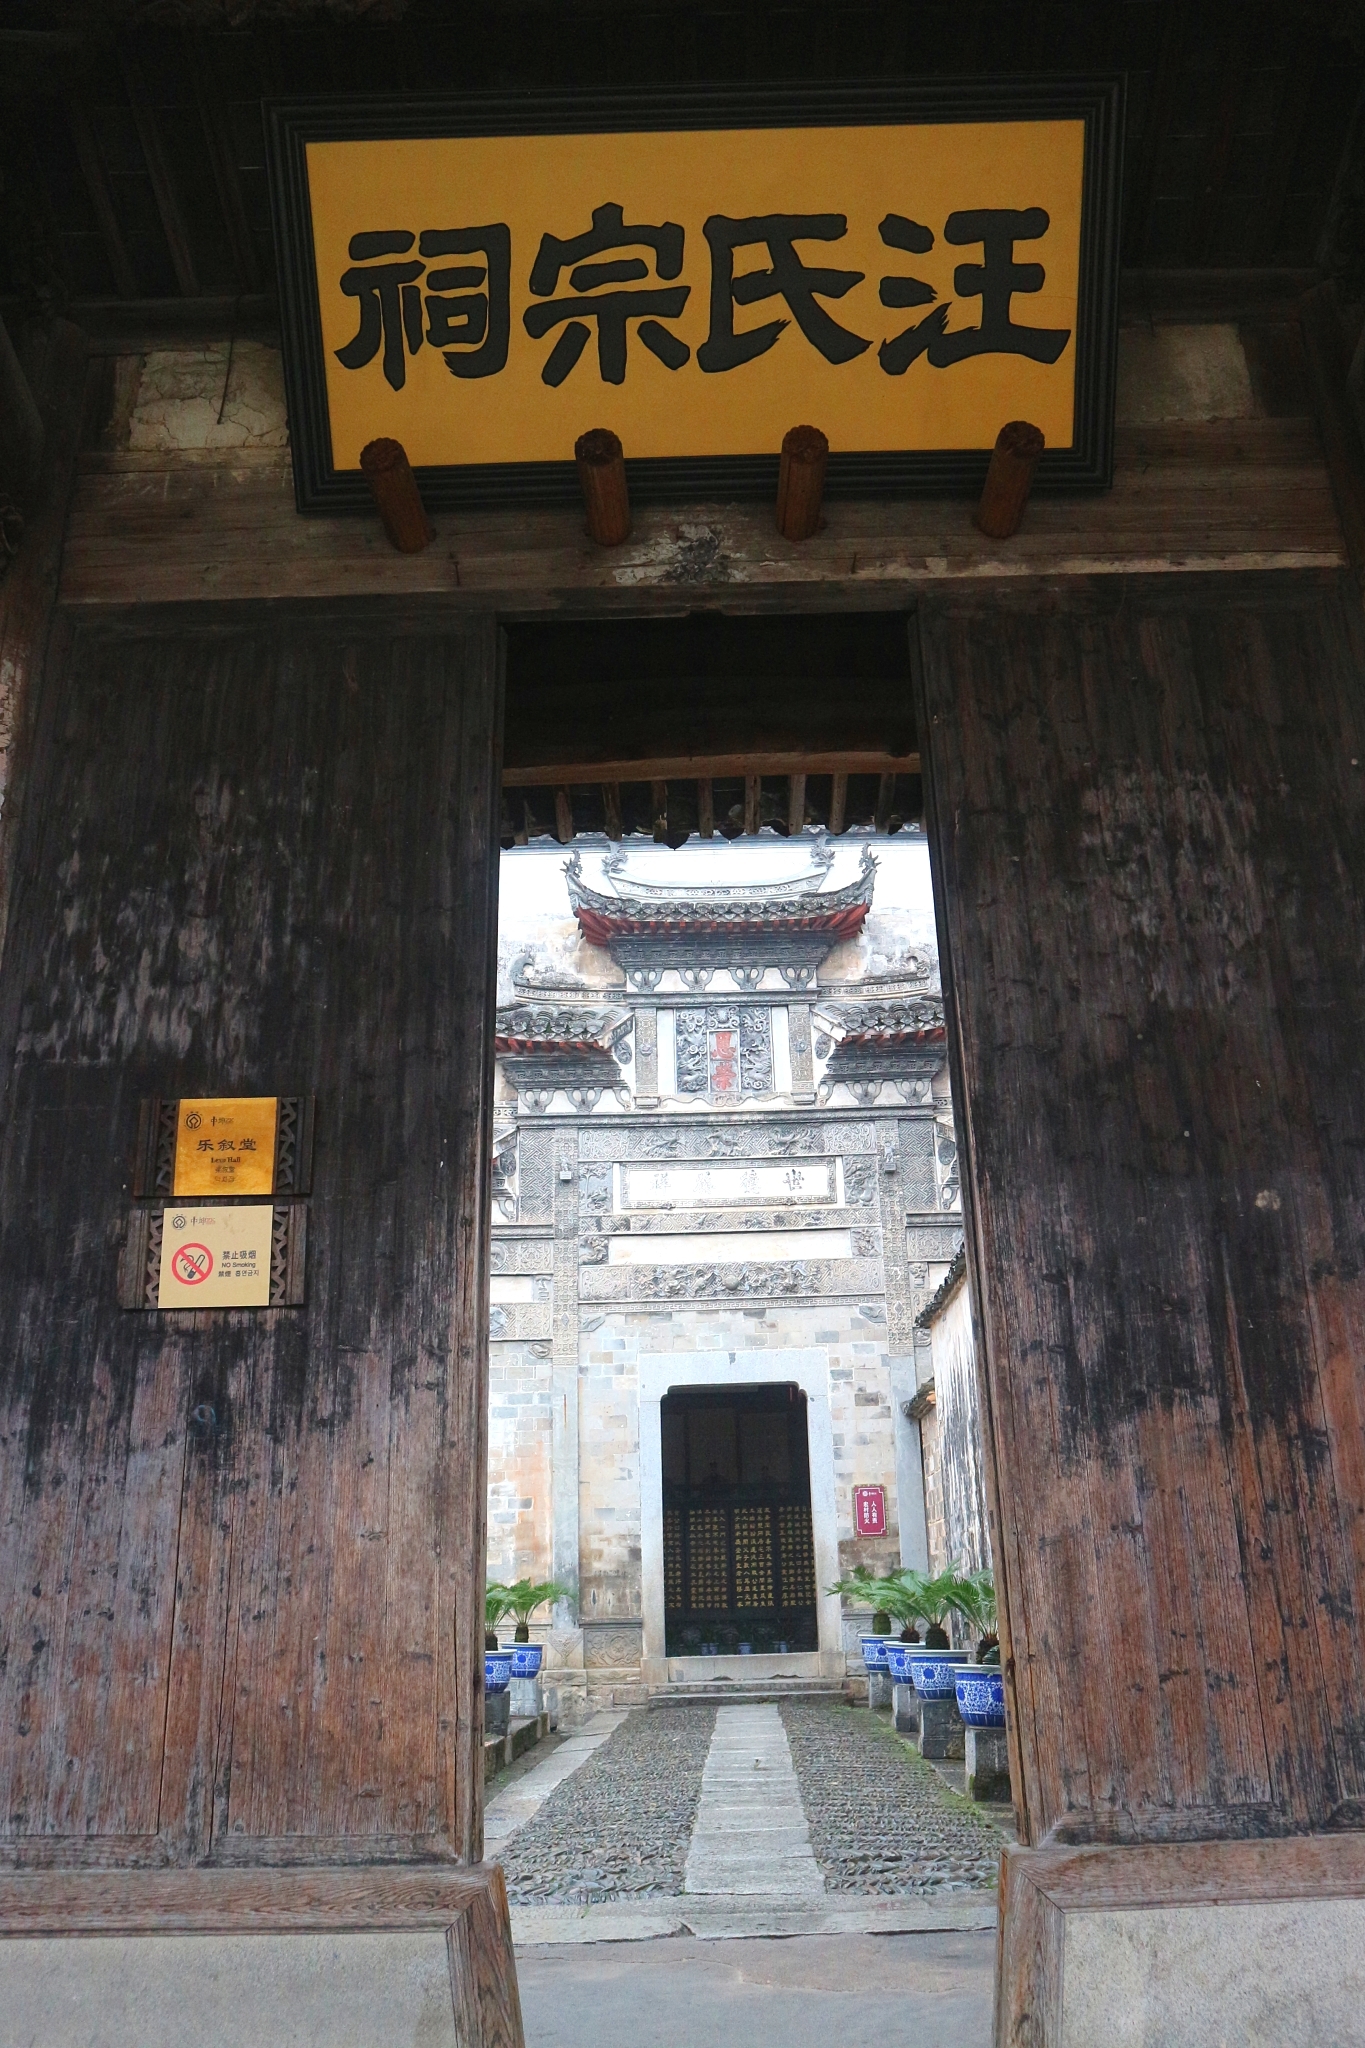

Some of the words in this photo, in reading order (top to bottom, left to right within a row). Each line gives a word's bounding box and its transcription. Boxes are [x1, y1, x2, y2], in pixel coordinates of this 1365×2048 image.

[334, 203, 1072, 390] 汪氏宗祠
[196, 1138, 257, 1151] 乐叙堂
[223, 1250, 256, 1260] 禁止吸烟
